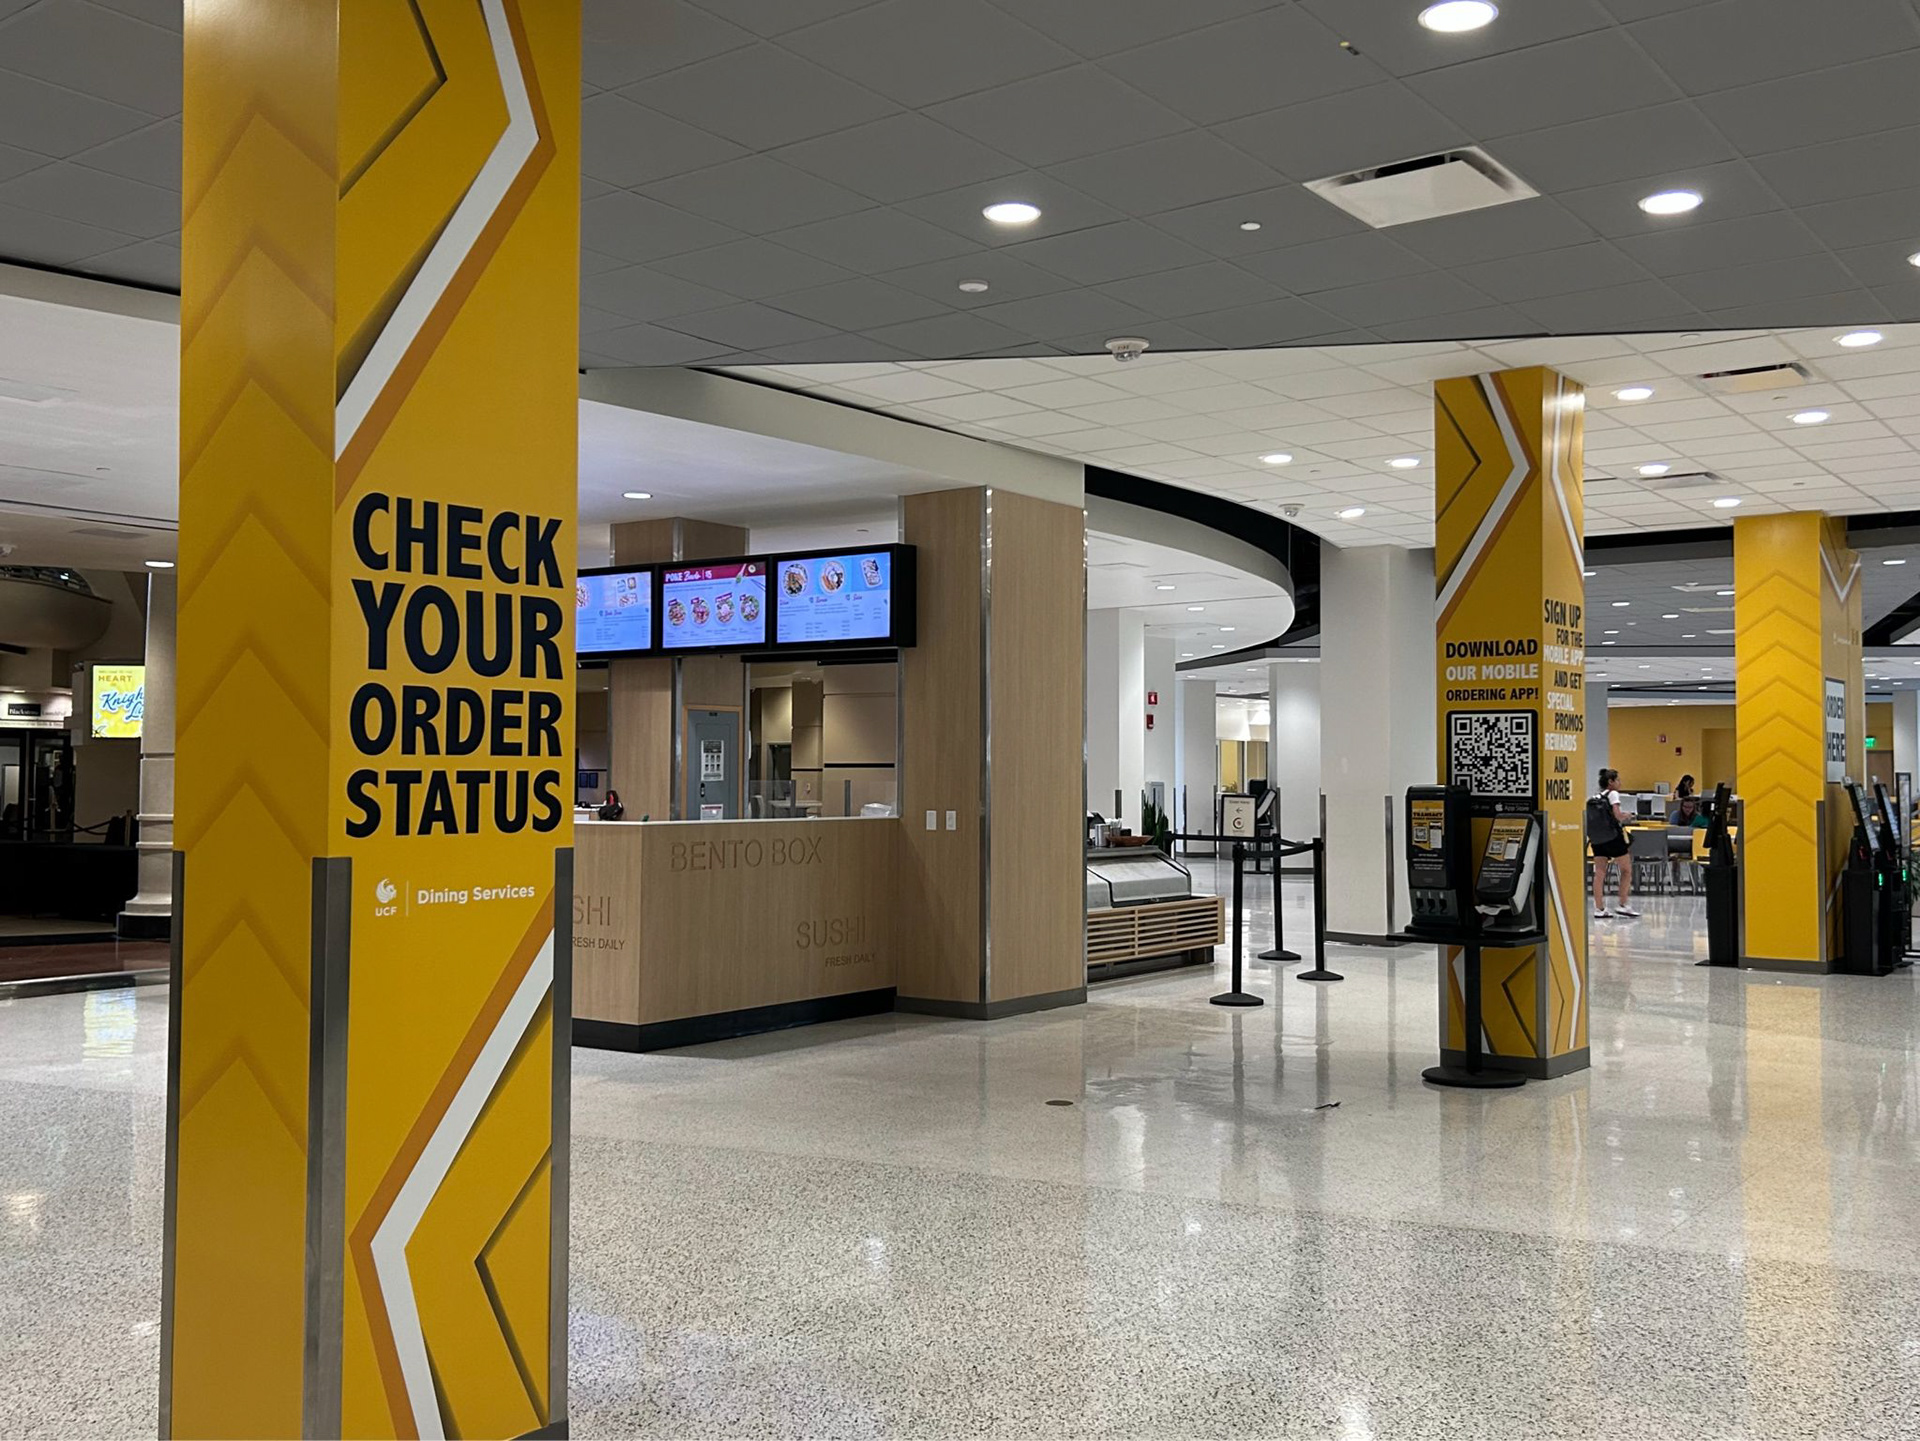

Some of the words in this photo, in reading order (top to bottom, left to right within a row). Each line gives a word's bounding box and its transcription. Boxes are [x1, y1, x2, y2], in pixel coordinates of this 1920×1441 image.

[353, 492, 564, 589] CHECK
[1544, 598, 1566, 626] SIGN
[1569, 604, 1581, 629] UP
[351, 578, 563, 679] YOUR
[1556, 628, 1569, 646] FOR
[1570, 630, 1583, 648] THE
[1445, 639, 1538, 659] DOWNLOAD
[1543, 644, 1569, 665] MOBILE
[1446, 665, 1477, 681] OUR
[1481, 663, 1539, 680] MOBILE
[1554, 670, 1568, 688] AND
[1569, 672, 1582, 690] GET
[1446, 688, 1506, 702] ORDERING
[1510, 687, 1539, 700] APP!
[1547, 691, 1575, 711] SPECIAL
[1827, 695, 1845, 719] ORDER
[350, 682, 563, 757] ORDER
[1554, 712, 1583, 732] PROMOS
[1544, 732, 1577, 752] REWARDS
[1827, 732, 1845, 762] HERE
[1554, 756, 1568, 773] AND
[346, 769, 563, 838] STATUS
[671, 839, 763, 872] BENTO
[772, 836, 822, 866] BOX
[417, 888, 468, 905] Dining
[473, 884, 535, 901] Services
[375, 906, 397, 917] UCF
[796, 916, 866, 950] SUSHI
[598, 938, 625, 950] DAILY
[825, 954, 852, 967] FRESH
